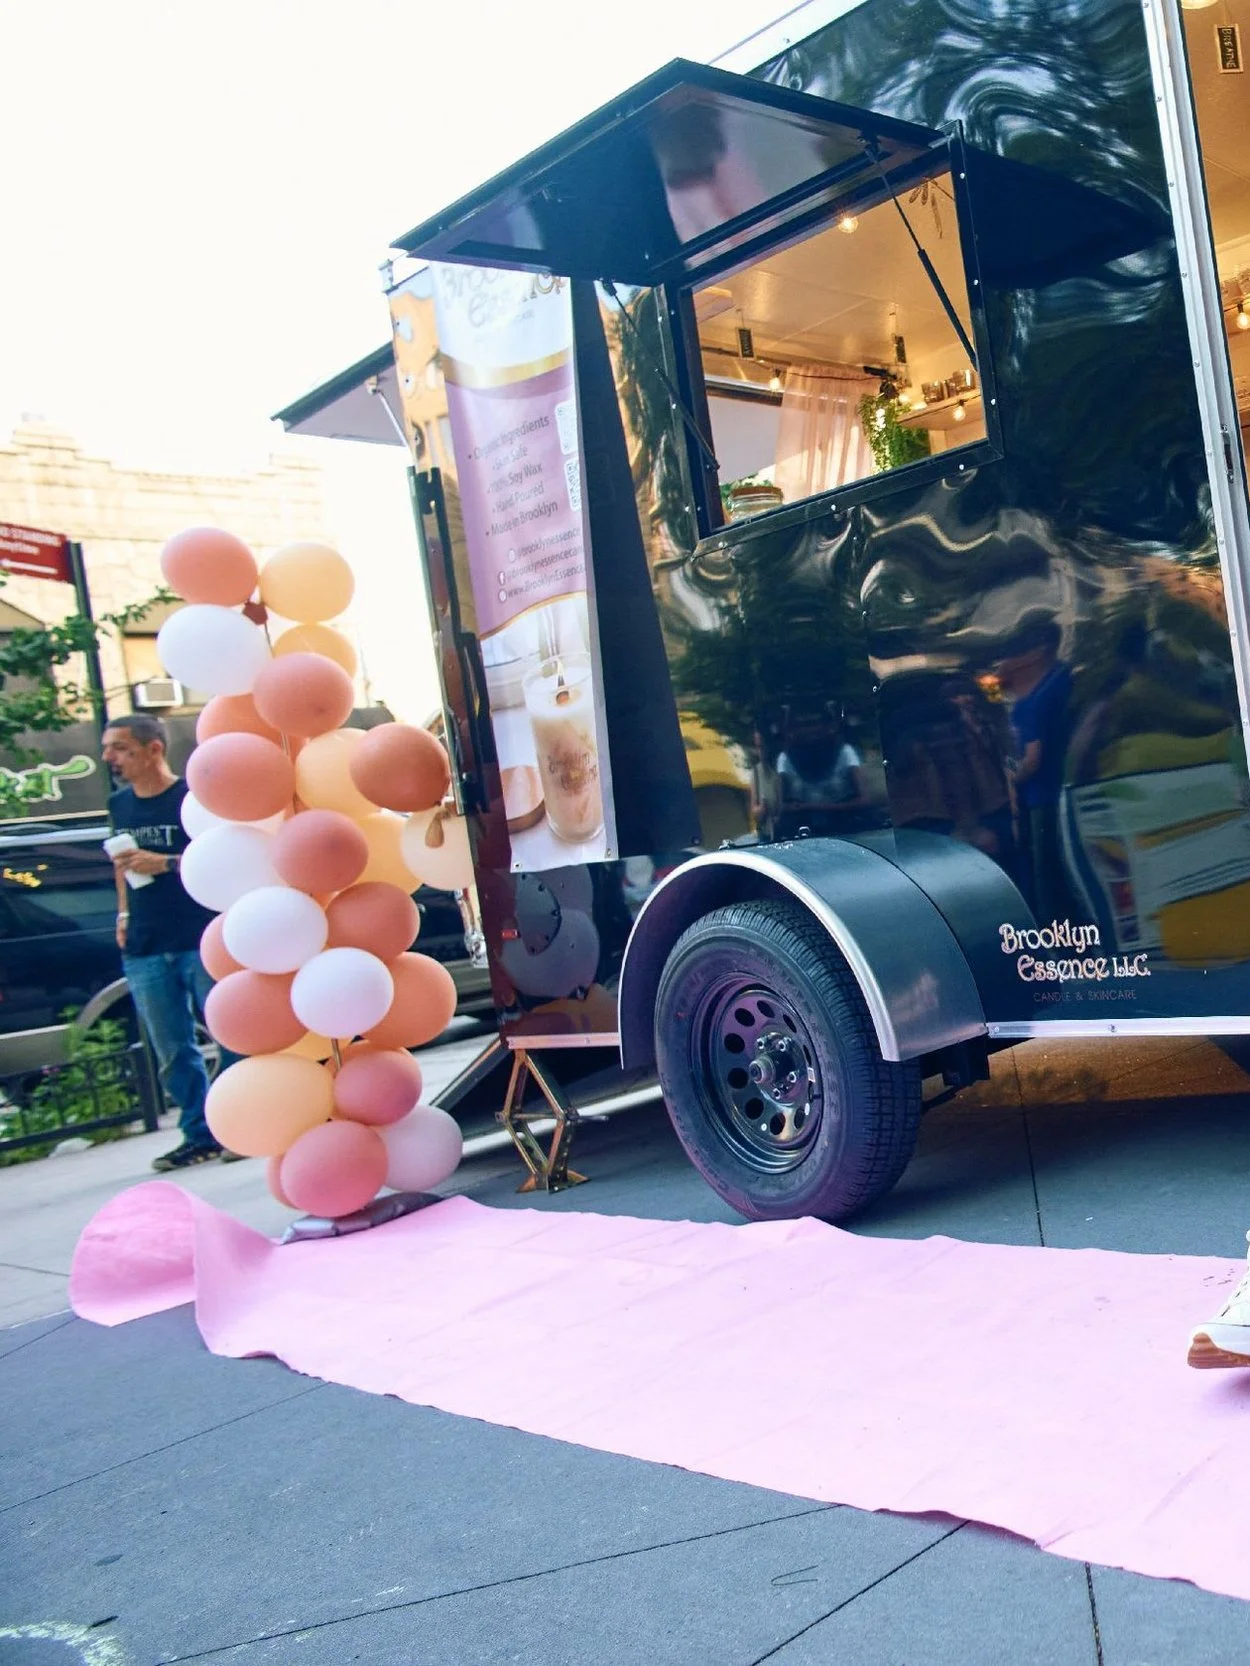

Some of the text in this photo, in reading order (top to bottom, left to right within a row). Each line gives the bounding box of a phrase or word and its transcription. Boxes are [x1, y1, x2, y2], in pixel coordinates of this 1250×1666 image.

[500, 415, 550, 446] Ingredients
[508, 469, 523, 485] Soy
[523, 462, 543, 478] Wax
[515, 483, 545, 501] Poured
[519, 501, 558, 524] Brooklyn
[999, 918, 1100, 954] Brooklyn
[1017, 954, 1110, 983] Essence
[1088, 989, 1137, 1001] SKINCARE
